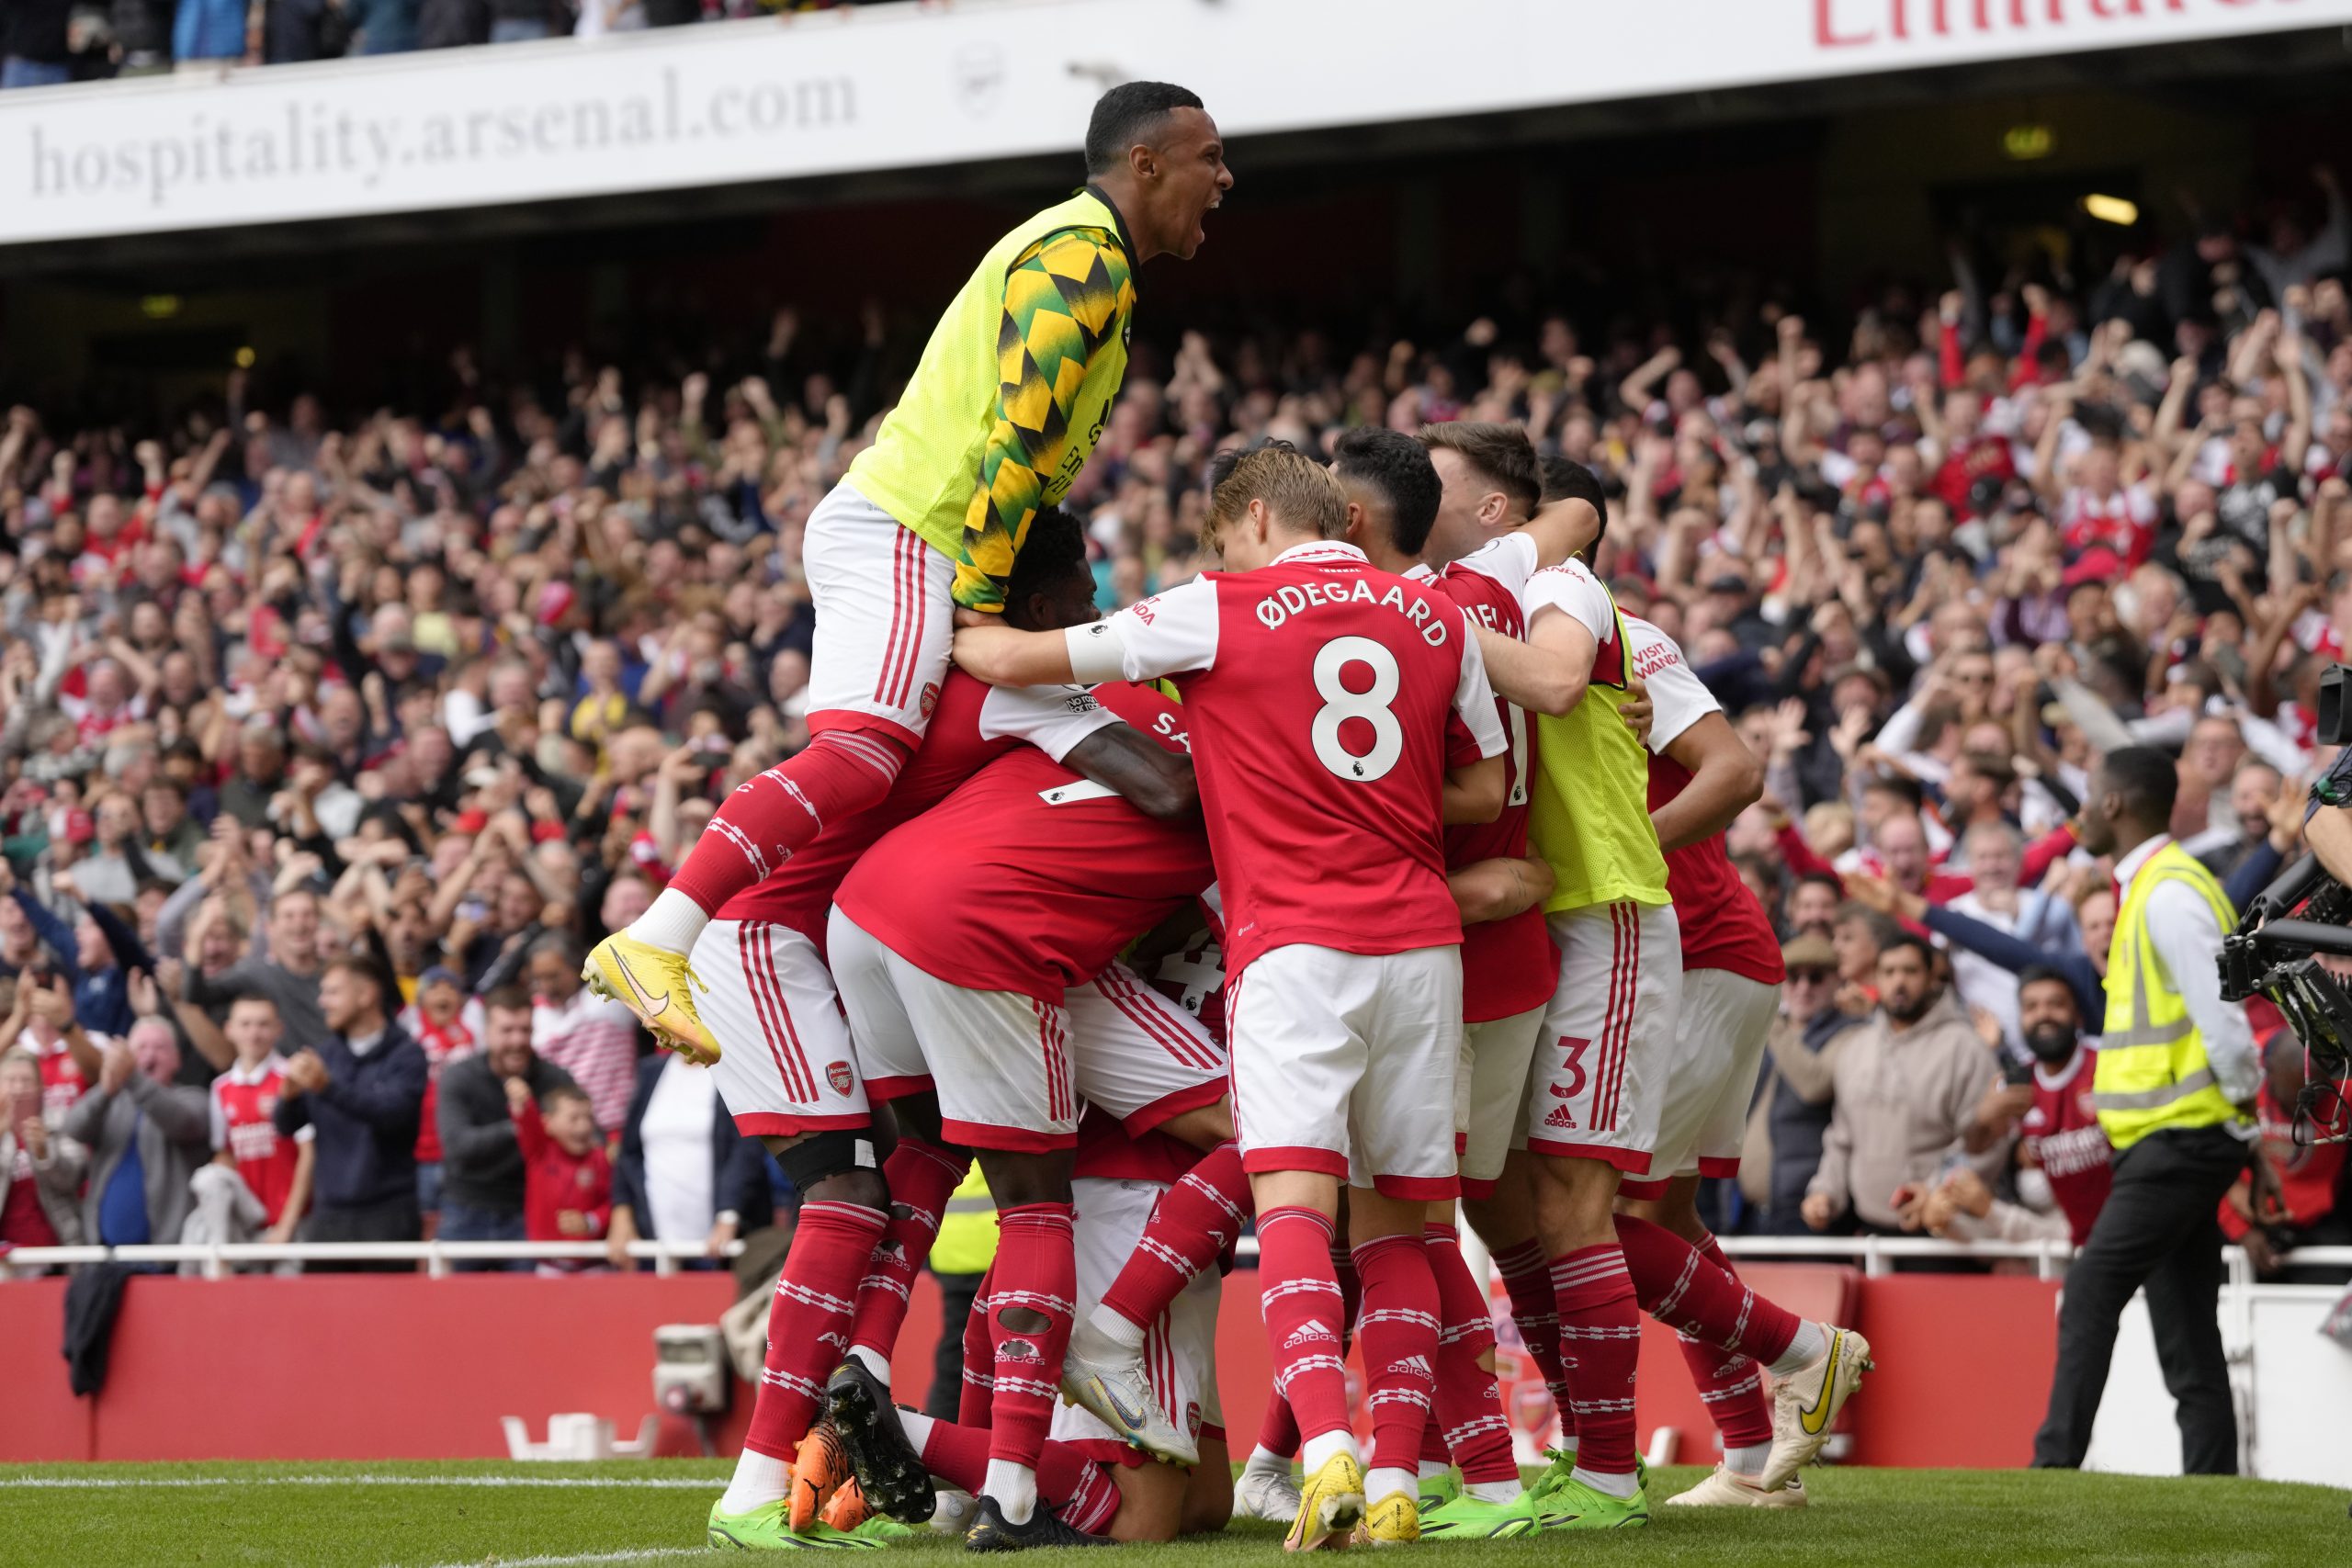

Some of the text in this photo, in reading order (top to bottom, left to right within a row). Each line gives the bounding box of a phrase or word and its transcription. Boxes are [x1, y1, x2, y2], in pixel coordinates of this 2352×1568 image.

[30, 64, 859, 208] hospitality.arsenal.com
[1255, 579, 1448, 648] ØDEGAARD
[1633, 642, 1666, 664] VISIT
[1066, 697, 1082, 708] No
[1310, 635, 1404, 784] 8
[1152, 712, 1191, 754] SA
[1508, 700, 1529, 807] 1
[1549, 1035, 1592, 1099] 3
[1544, 1117, 1577, 1130] adidas
[1283, 1332, 1339, 1350] adidas
[1386, 1363, 1434, 1385] adidas
